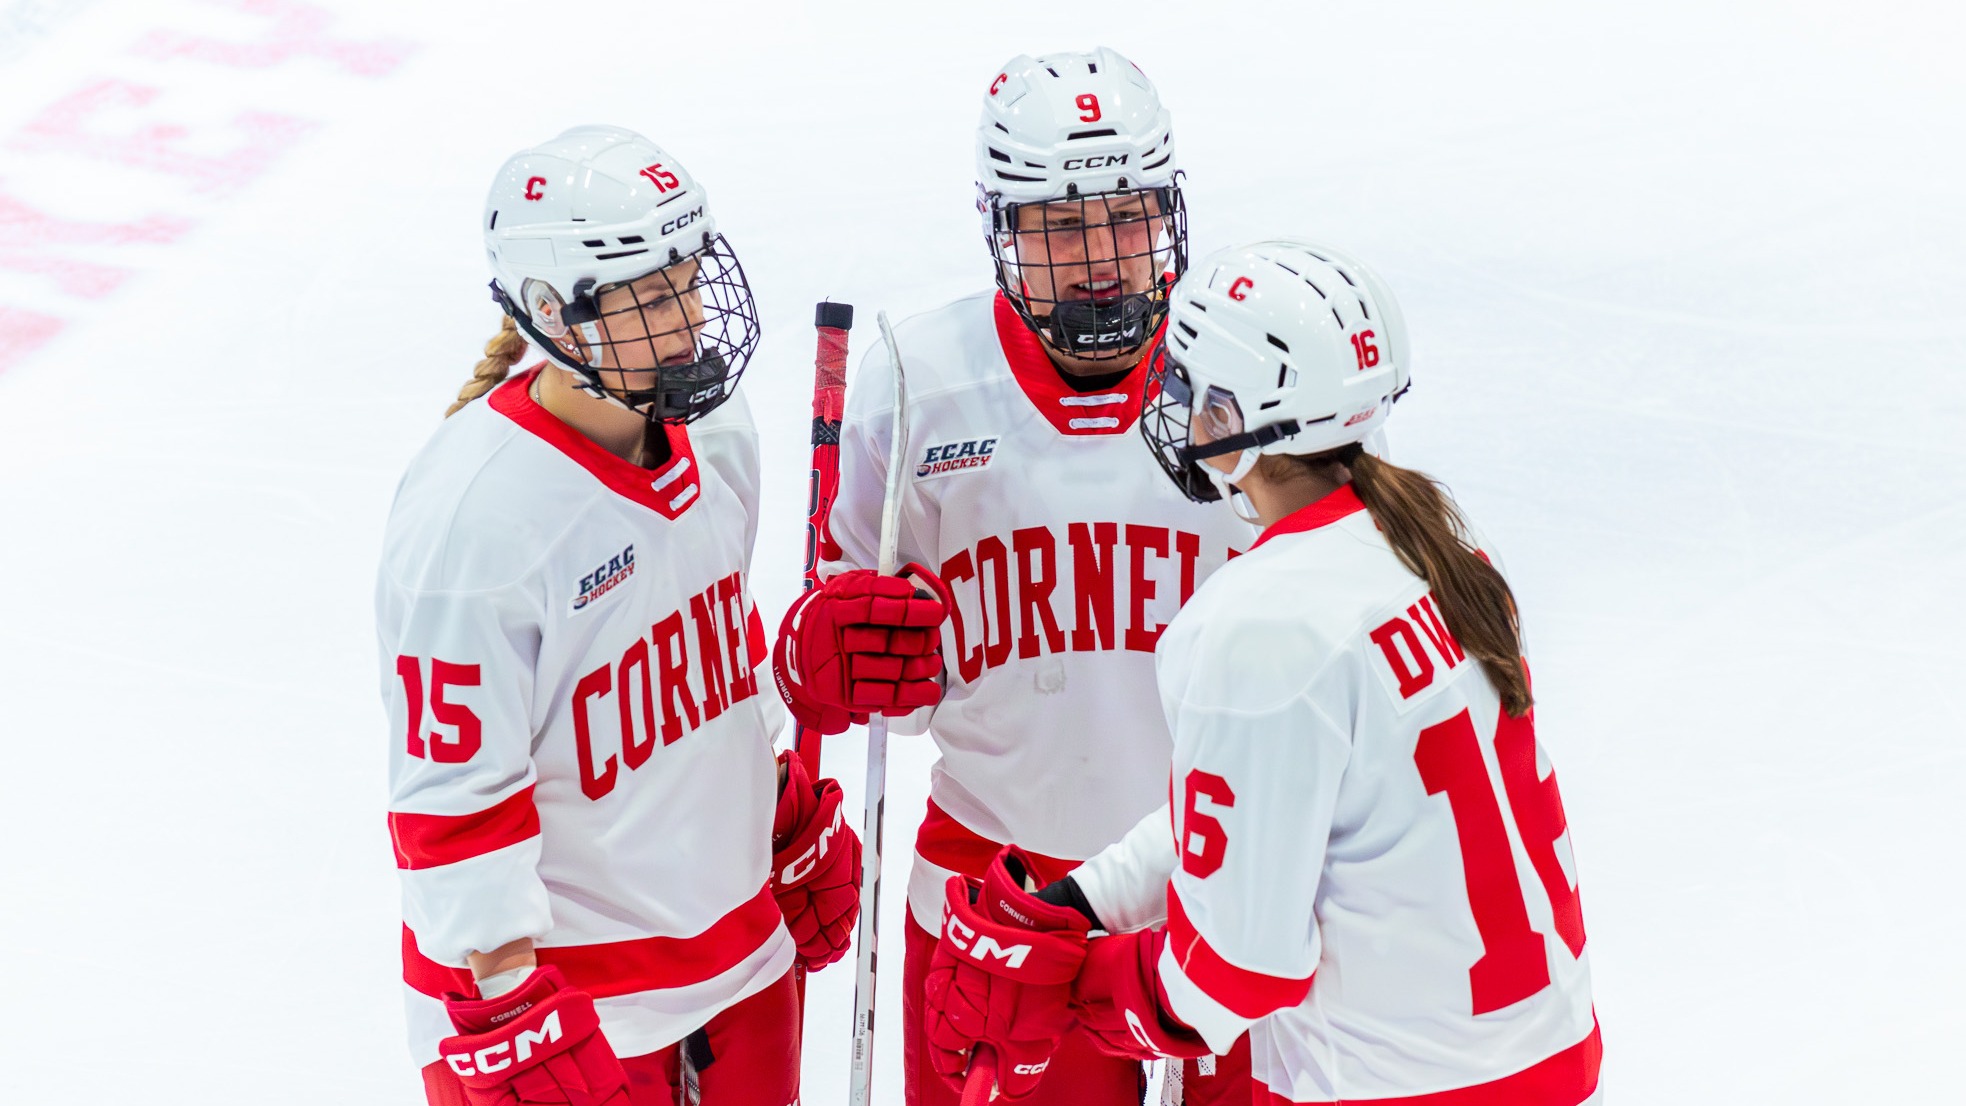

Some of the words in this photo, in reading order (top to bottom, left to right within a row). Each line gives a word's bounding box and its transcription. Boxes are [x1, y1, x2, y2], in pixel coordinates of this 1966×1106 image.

[989, 72, 1008, 96] C
[1075, 93, 1102, 122] 9
[1063, 153, 1129, 170] CCM
[524, 176, 546, 201] C
[639, 163, 679, 193] 15
[661, 205, 703, 236] CCM
[1228, 276, 1254, 302] C
[1077, 327, 1137, 345] CCM
[1350, 329, 1380, 371] 16
[689, 383, 722, 404] CC
[924, 438, 998, 464] ECAC
[931, 455, 992, 474] HOCKEY
[579, 543, 634, 596] ECAC
[589, 562, 635, 602] HOCKEY
[396, 654, 482, 764] 15
[1169, 760, 1236, 880] 6
[769, 800, 842, 888] CM
[490, 1001, 533, 1024] CORNELL
[446, 1009, 564, 1077] CCM
[1013, 1056, 1050, 1075] CC
